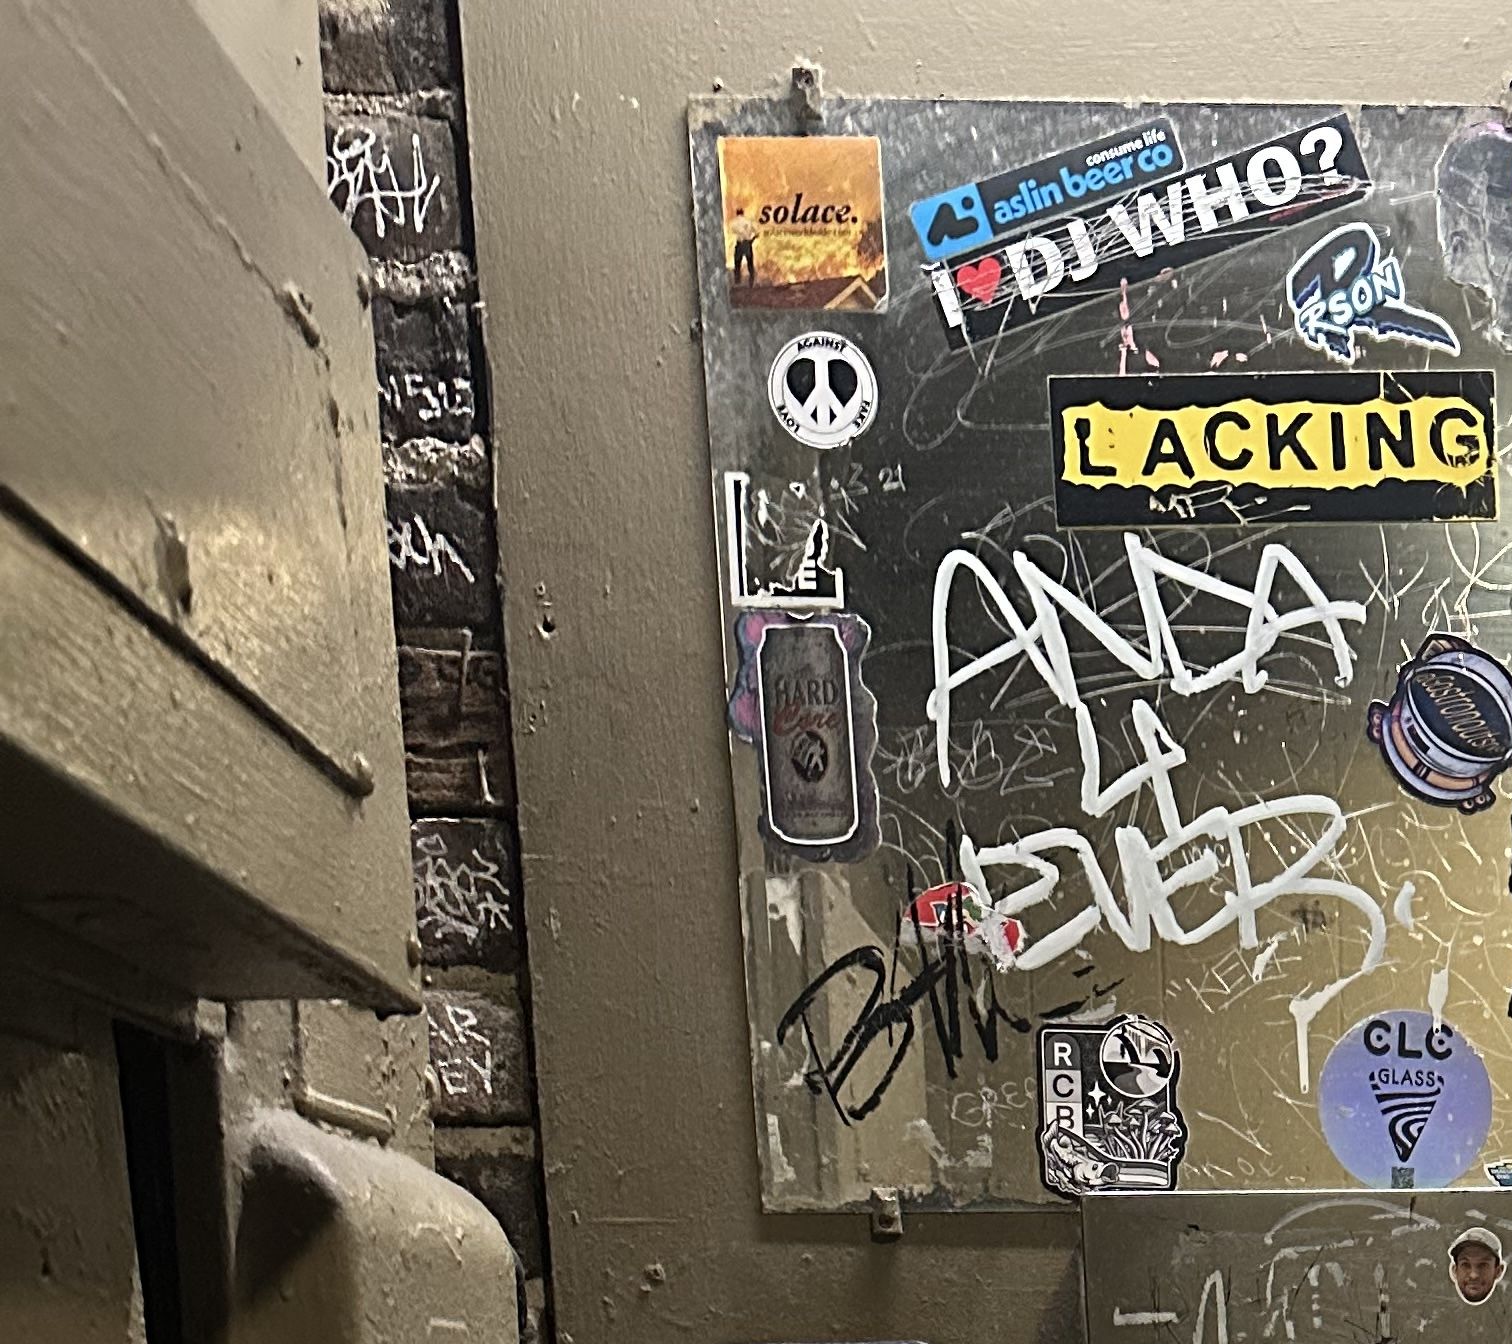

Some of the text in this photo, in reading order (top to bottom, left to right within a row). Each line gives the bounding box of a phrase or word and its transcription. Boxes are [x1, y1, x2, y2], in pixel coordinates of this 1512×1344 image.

[1086, 127, 1167, 167] consume life
[993, 143, 1174, 226] aslin beer co
[759, 193, 858, 225] solace.
[1005, 217, 1100, 302] DJ
[1106, 126, 1345, 259] WHO?
[797, 337, 847, 352] AGAINST
[776, 404, 801, 434] LOVE
[852, 400, 871, 429] FAKE
[1074, 407, 1480, 479] LACKING
[1377, 1068, 1436, 1087] GLASS
